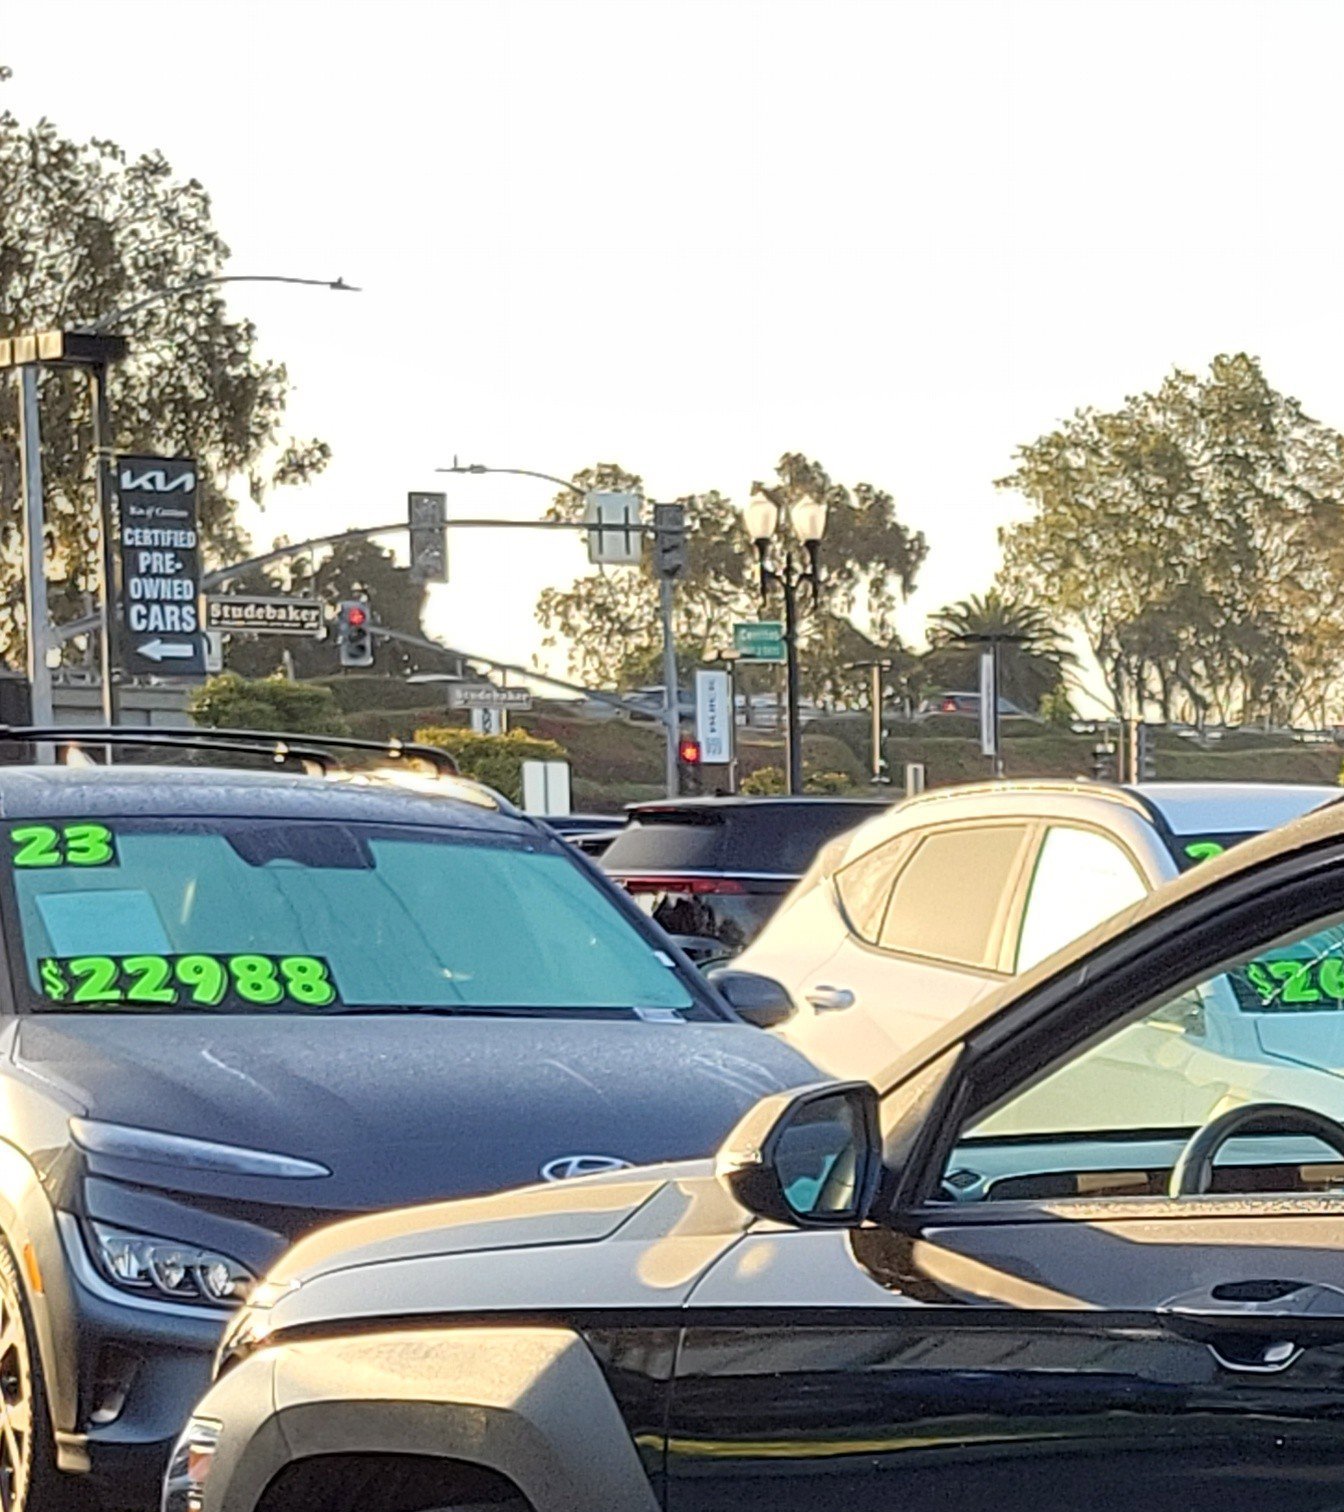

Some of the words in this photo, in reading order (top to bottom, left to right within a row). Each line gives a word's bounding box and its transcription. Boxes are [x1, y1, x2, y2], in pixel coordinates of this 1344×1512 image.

[120, 469, 196, 493] KIA
[123, 528, 197, 549] CERTIFIED
[138, 551, 183, 575] PRE-
[129, 577, 195, 601] OWNED
[130, 604, 197, 633] CARS
[210, 602, 321, 622] Studebaker
[10, 824, 114, 867] 23
[41, 955, 337, 1006] $22988
